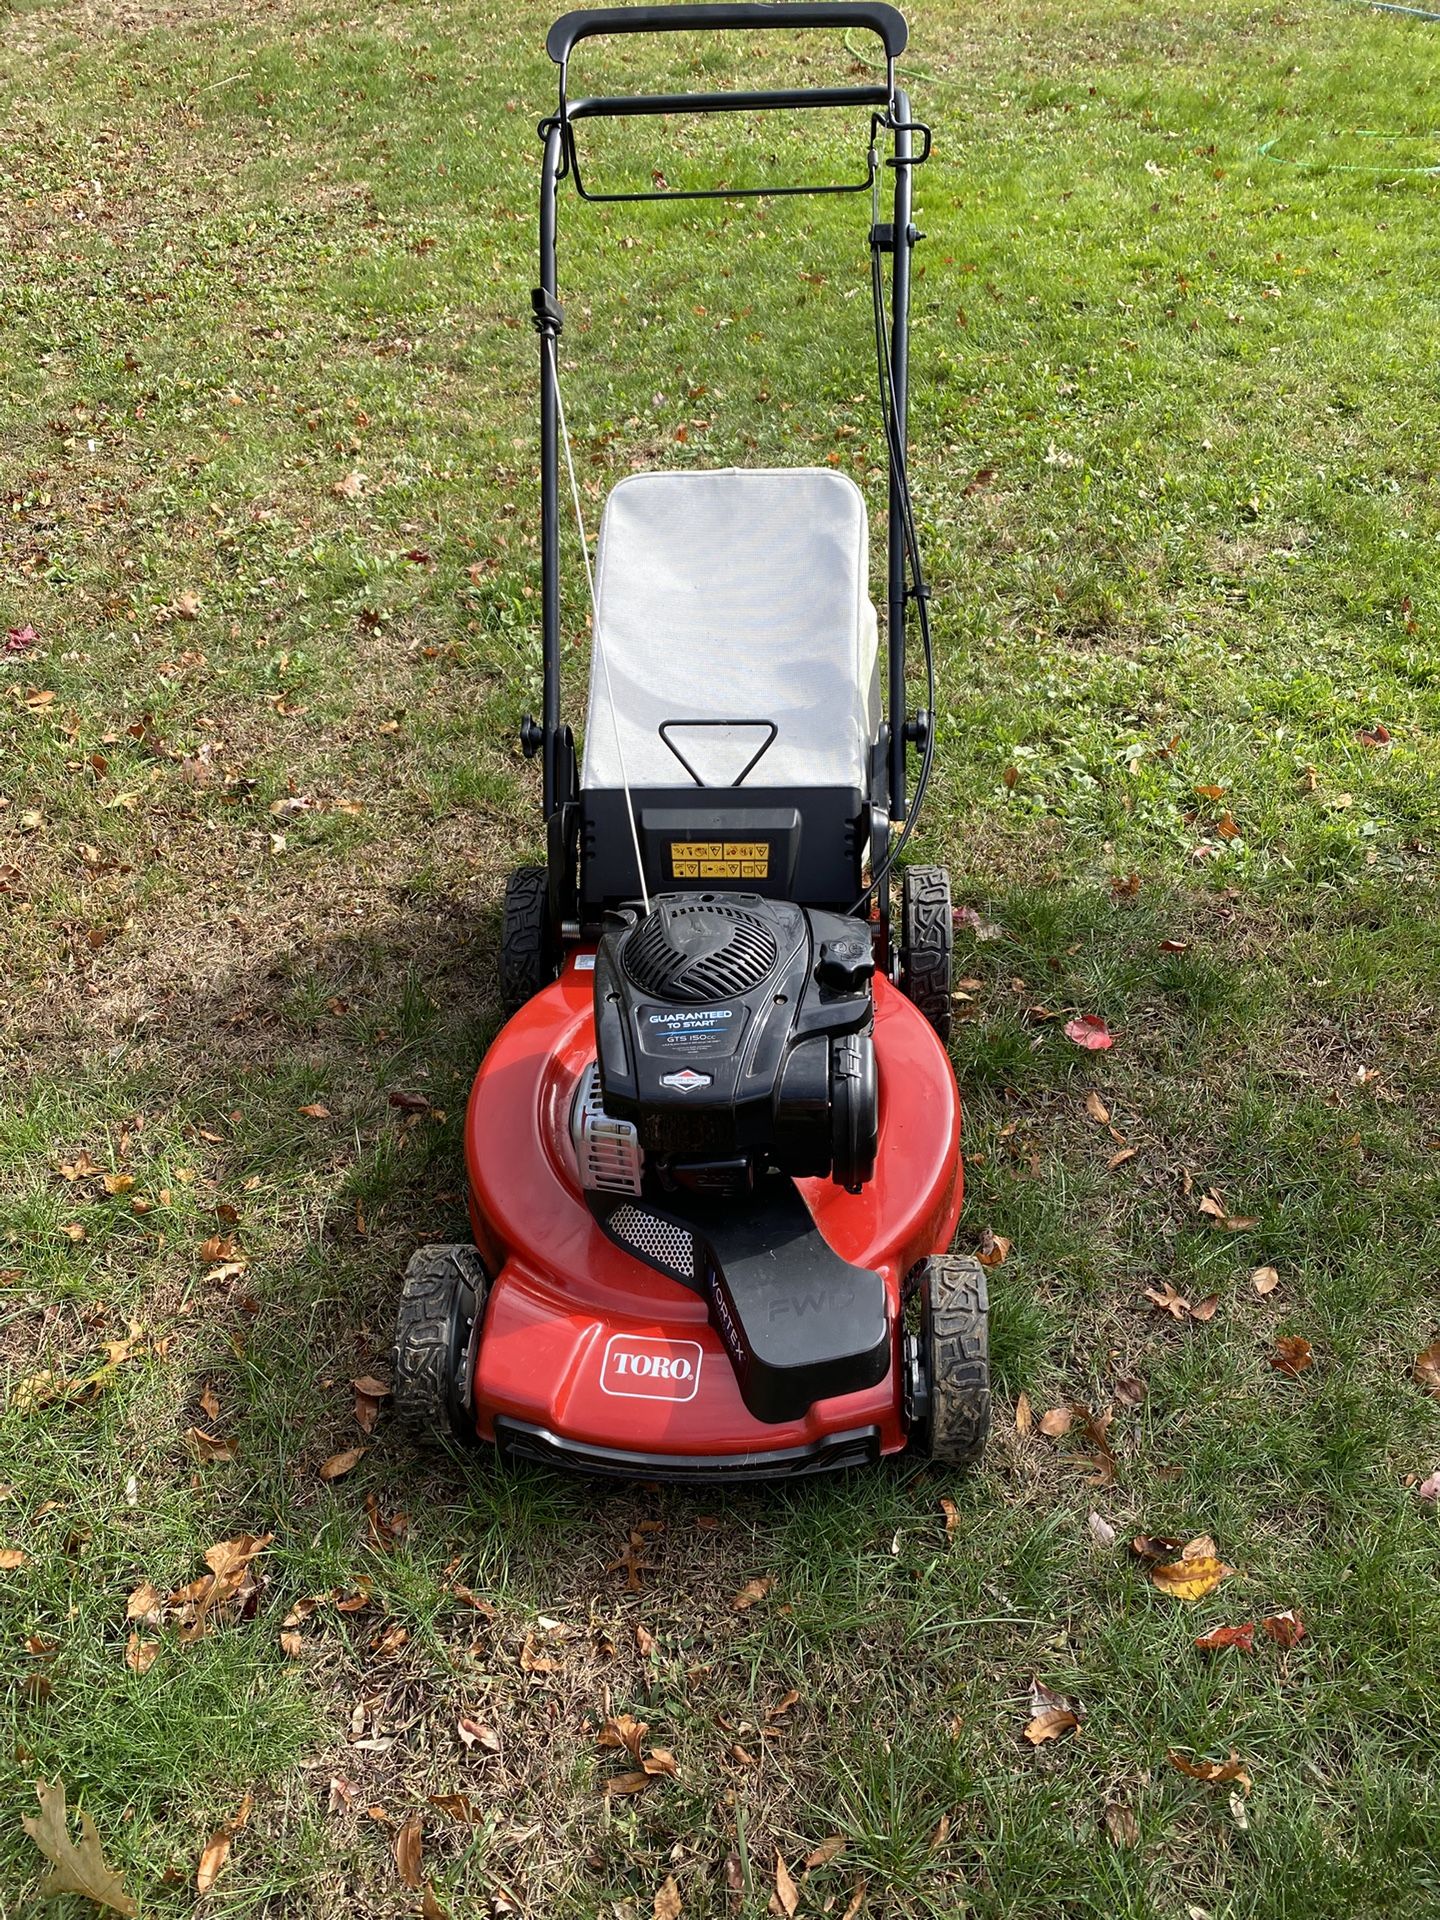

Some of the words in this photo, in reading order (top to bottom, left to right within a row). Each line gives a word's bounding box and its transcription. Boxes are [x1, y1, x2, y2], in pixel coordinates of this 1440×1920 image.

[649, 1010, 733, 1023] GUARANTEED
[711, 1271, 744, 1361] VORTEX
[768, 1289, 856, 1322] FWD
[613, 1352, 691, 1380] TORO
